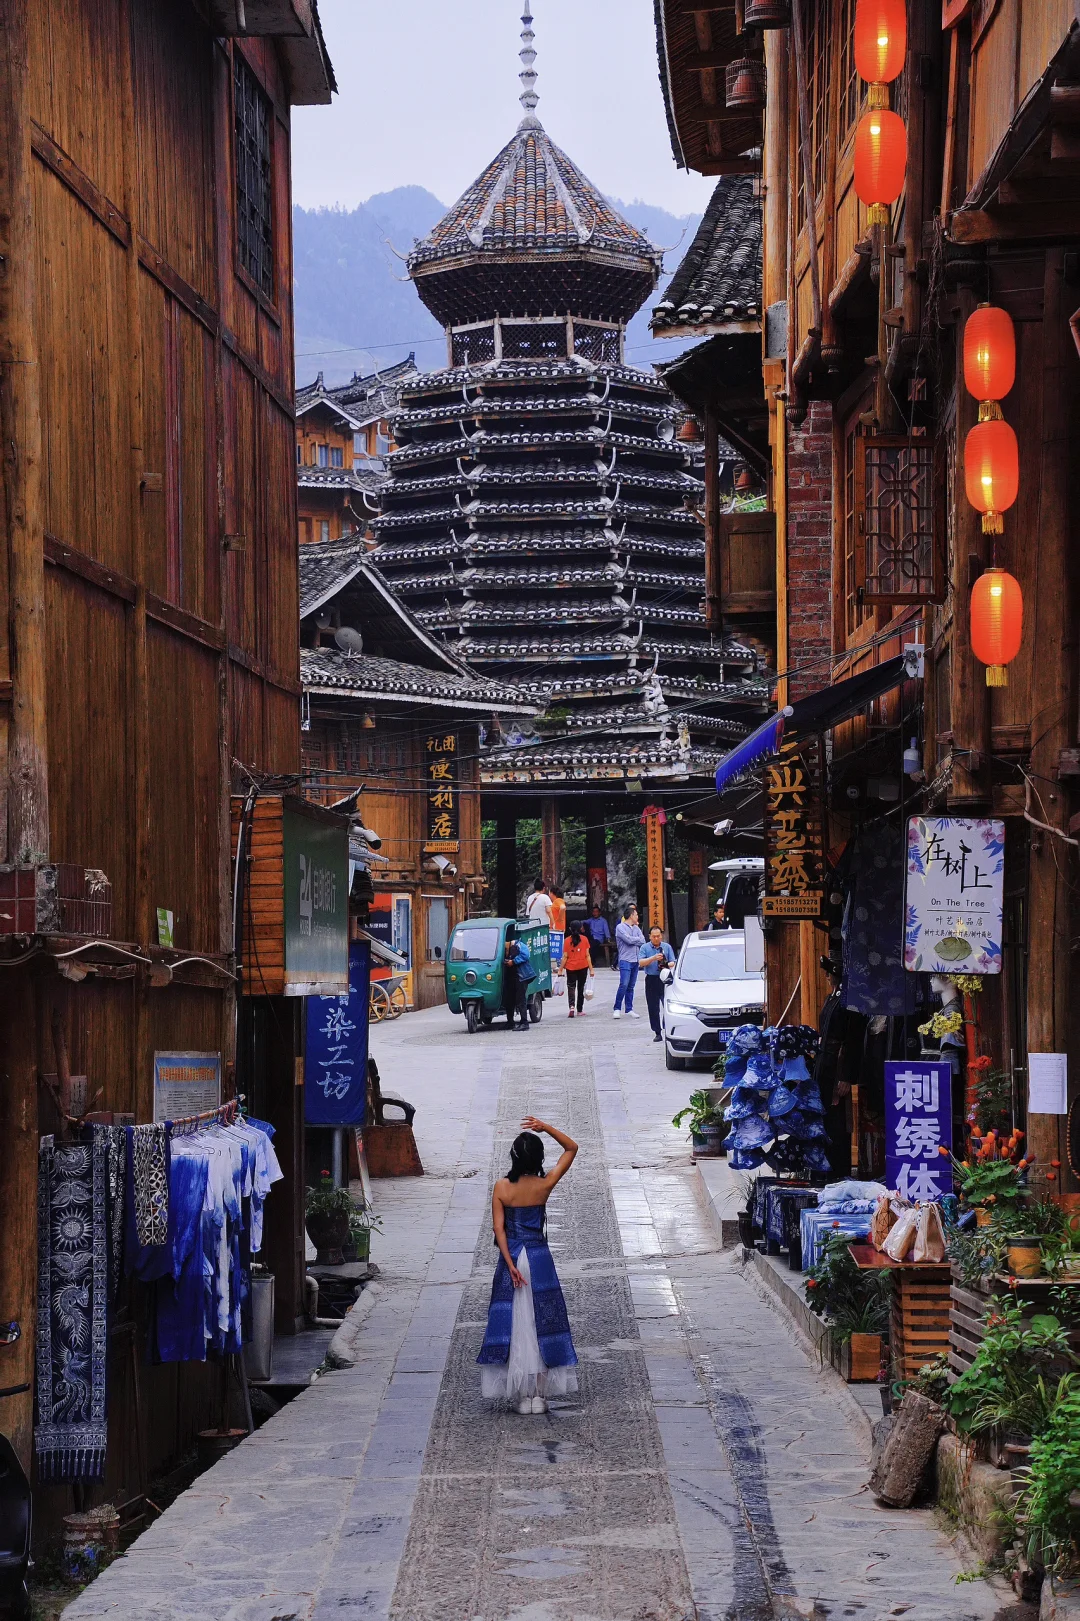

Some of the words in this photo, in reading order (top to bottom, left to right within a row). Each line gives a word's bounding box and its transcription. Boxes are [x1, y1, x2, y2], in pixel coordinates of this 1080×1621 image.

[429, 757, 454, 837] 便利店
[313, 867, 336, 914] 自助银行
[919, 833, 993, 894] 在树上
[930, 897, 942, 906] On
[946, 898, 961, 907] The
[966, 899, 986, 908] Tree
[893, 1070, 942, 1204] 刺绣体
